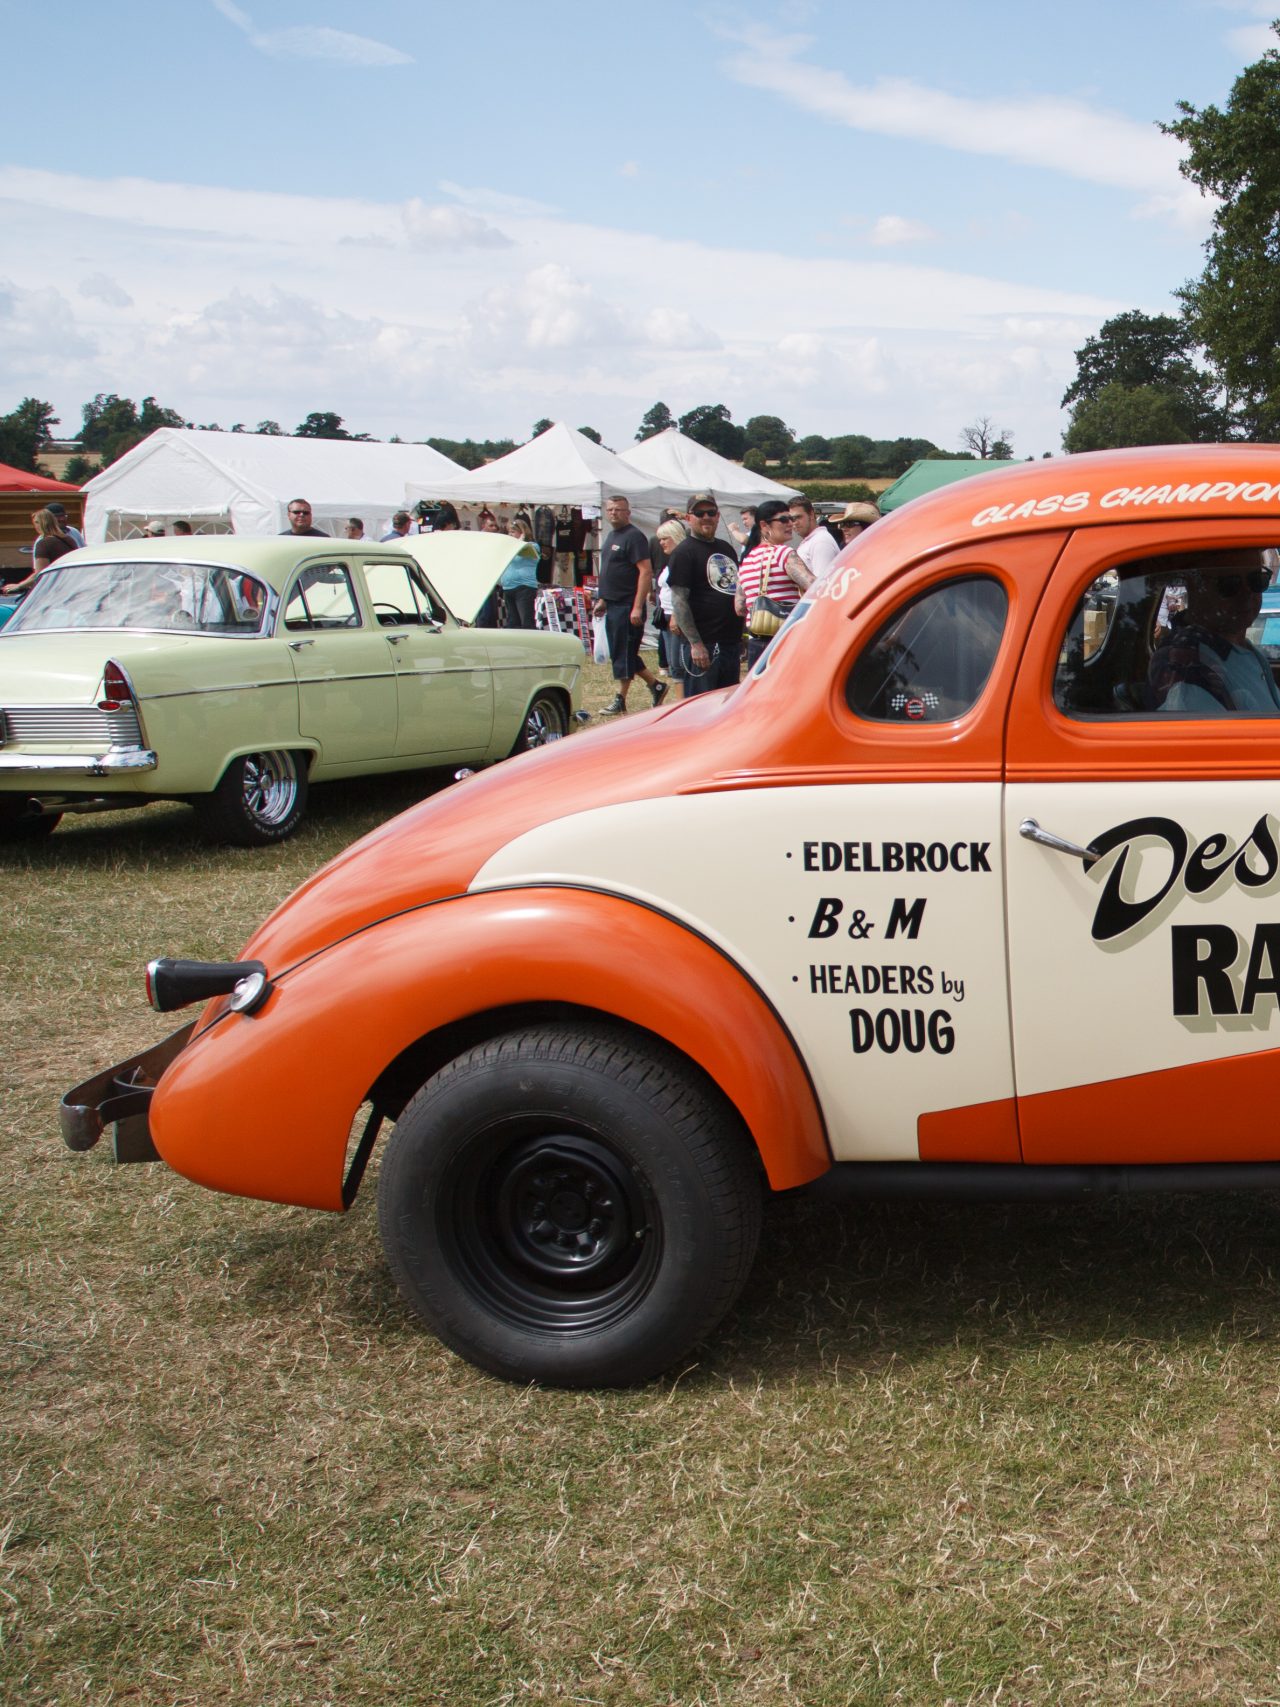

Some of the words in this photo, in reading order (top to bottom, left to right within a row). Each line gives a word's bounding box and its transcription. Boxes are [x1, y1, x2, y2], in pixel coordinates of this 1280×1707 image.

[971, 491, 1090, 528] CLASS
[803, 841, 993, 873] EDELBROCK
[807, 897, 844, 939] B
[847, 909, 875, 940] &
[884, 897, 928, 940] M
[809, 964, 934, 995] HEADERS
[941, 971, 965, 1003] by
[848, 1008, 956, 1055] DOUG
